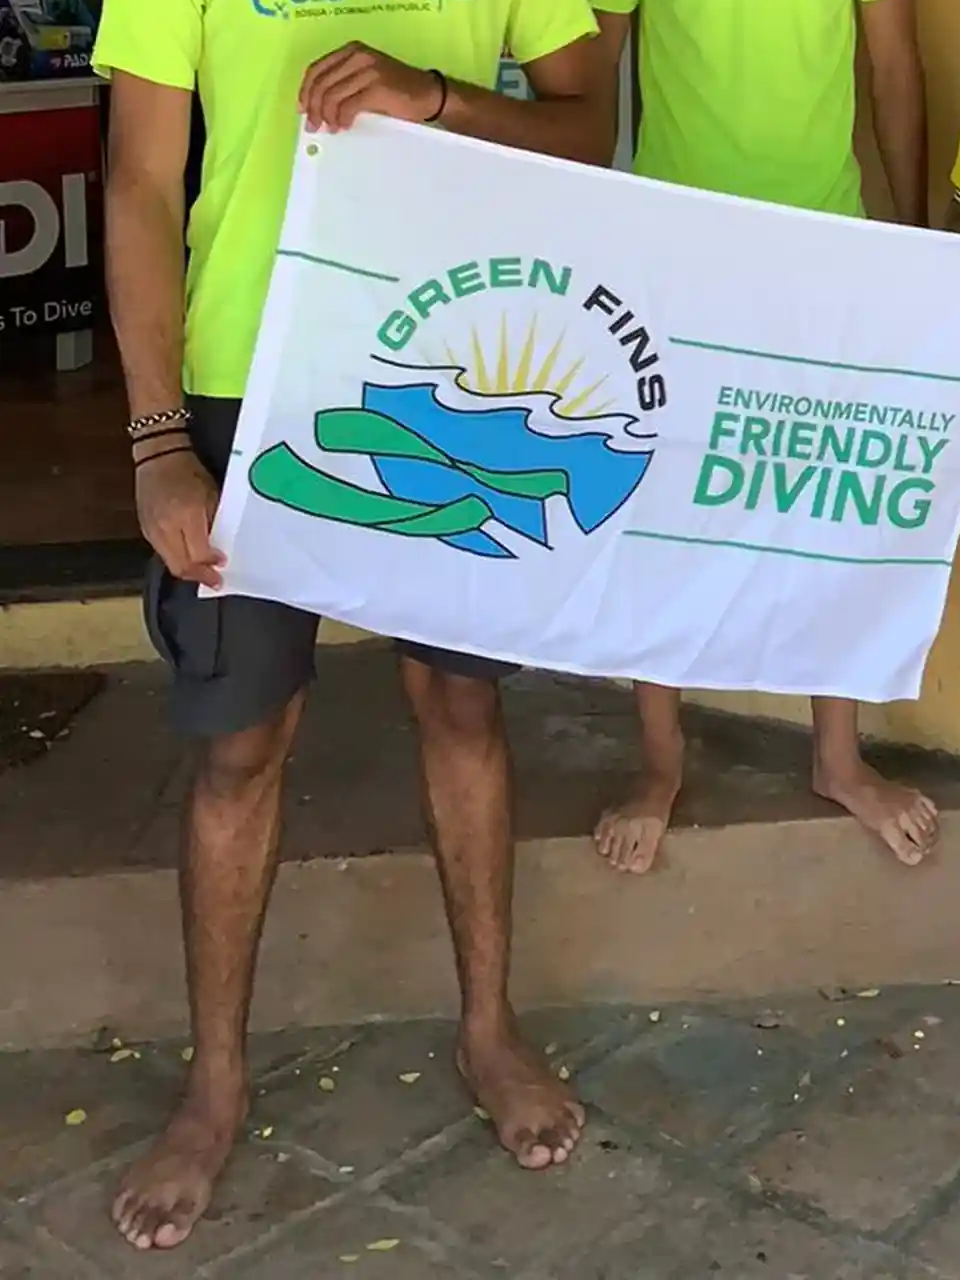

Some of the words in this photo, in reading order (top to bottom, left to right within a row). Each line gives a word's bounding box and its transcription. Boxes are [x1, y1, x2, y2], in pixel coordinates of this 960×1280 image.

[9, 306, 37, 328] To
[44, 300, 92, 322] Dive
[376, 257, 573, 351] GREEN
[582, 284, 668, 411] FINS
[717, 385, 956, 433] ENVIRONMENTALLY
[709, 411, 950, 474] FRIENDLY
[692, 453, 936, 529] DIVING
